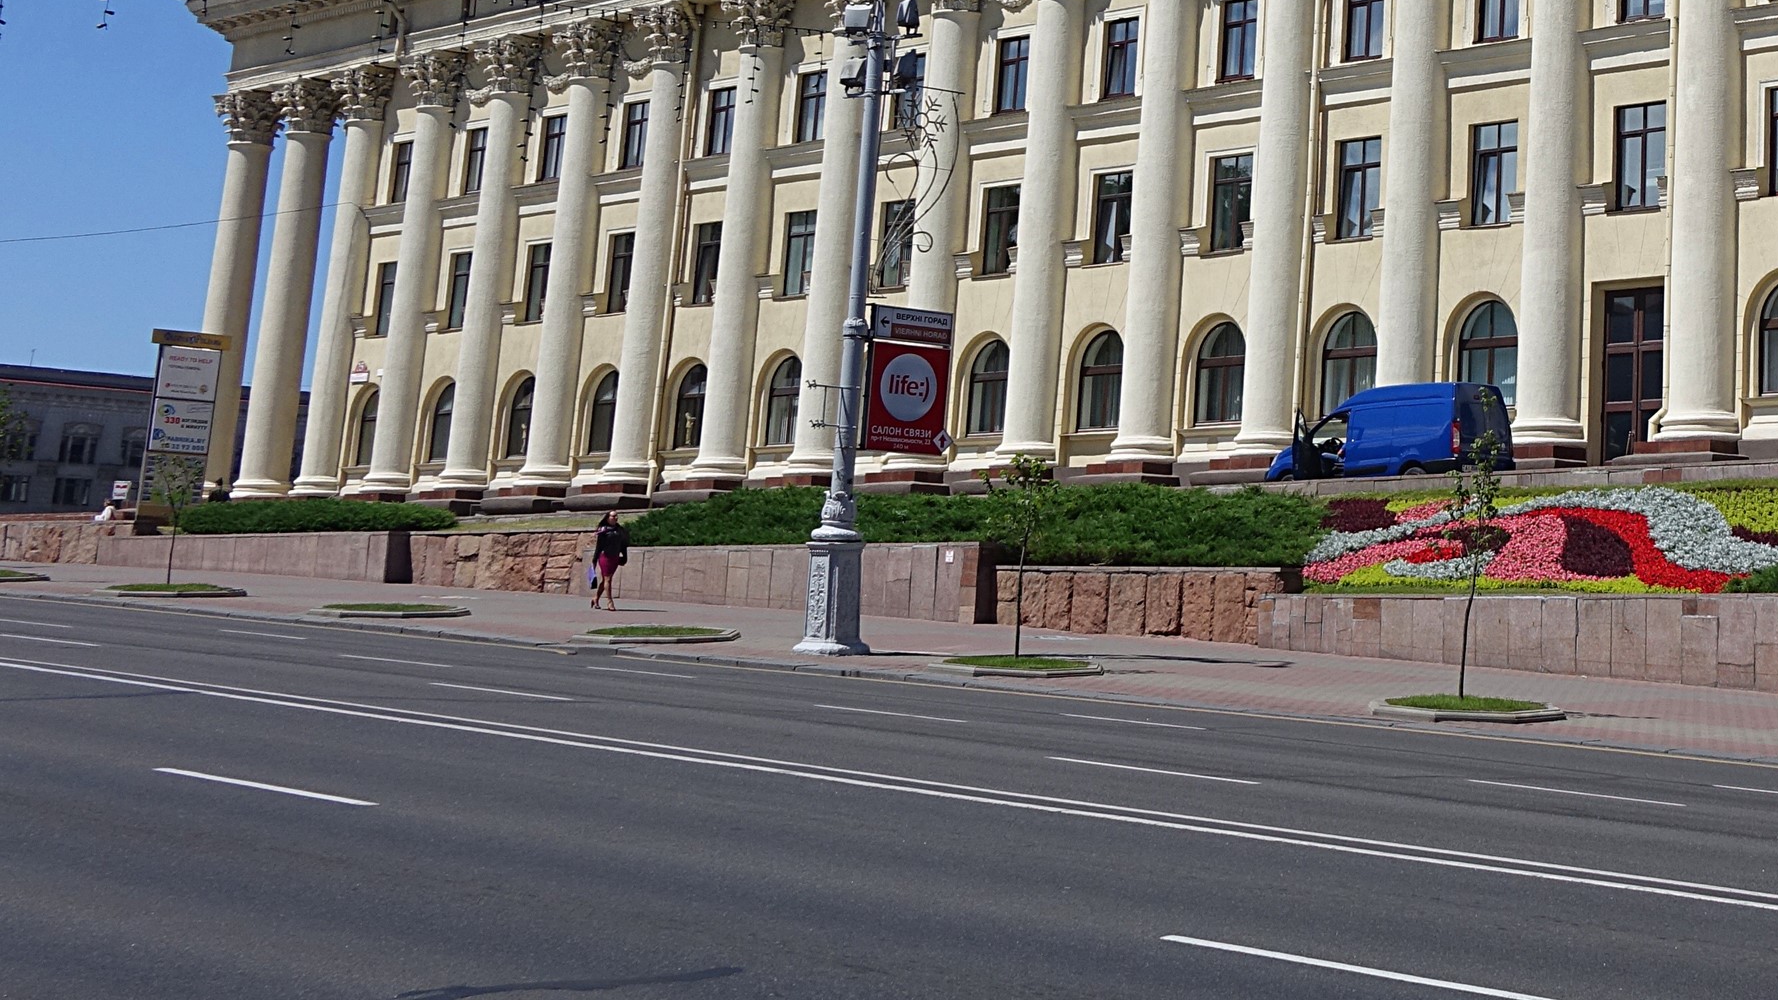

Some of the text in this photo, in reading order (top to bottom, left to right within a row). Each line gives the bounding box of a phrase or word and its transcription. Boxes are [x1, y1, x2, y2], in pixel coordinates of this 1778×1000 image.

[896, 312, 948, 326] ВЕРХНІ ГОРАД
[923, 331, 948, 339] HORAD
[888, 374, 930, 403] life:)
[871, 425, 932, 438] САЛОН СВЯЗИ
